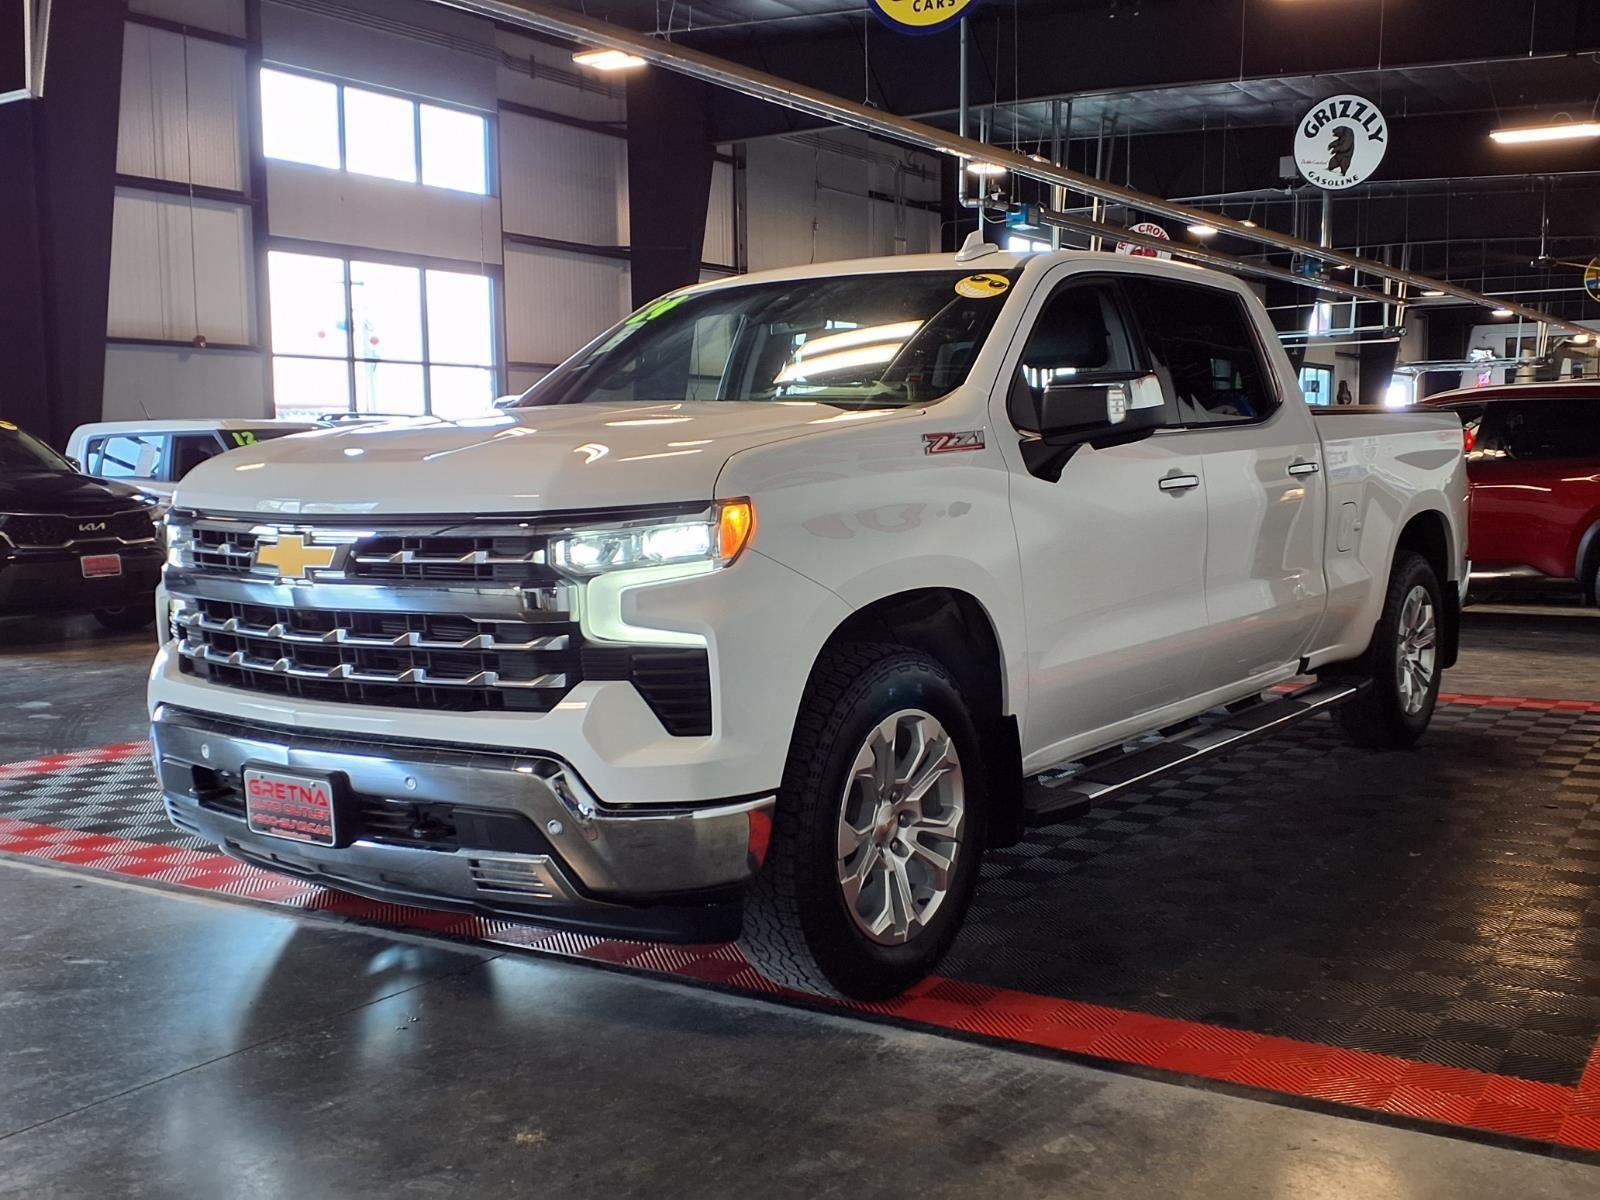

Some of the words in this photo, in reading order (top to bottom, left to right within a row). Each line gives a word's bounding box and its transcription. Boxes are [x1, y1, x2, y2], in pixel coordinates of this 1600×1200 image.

[912, 0, 955, 12] CARS
[1304, 100, 1384, 143] GRIZZLY
[1308, 171, 1359, 186] GASOLINE
[1138, 224, 1168, 240] CROW
[921, 430, 985, 456] Z71
[79, 522, 105, 531] KIA
[249, 779, 328, 807] GRETNA
[283, 803, 330, 820] OUTLET
